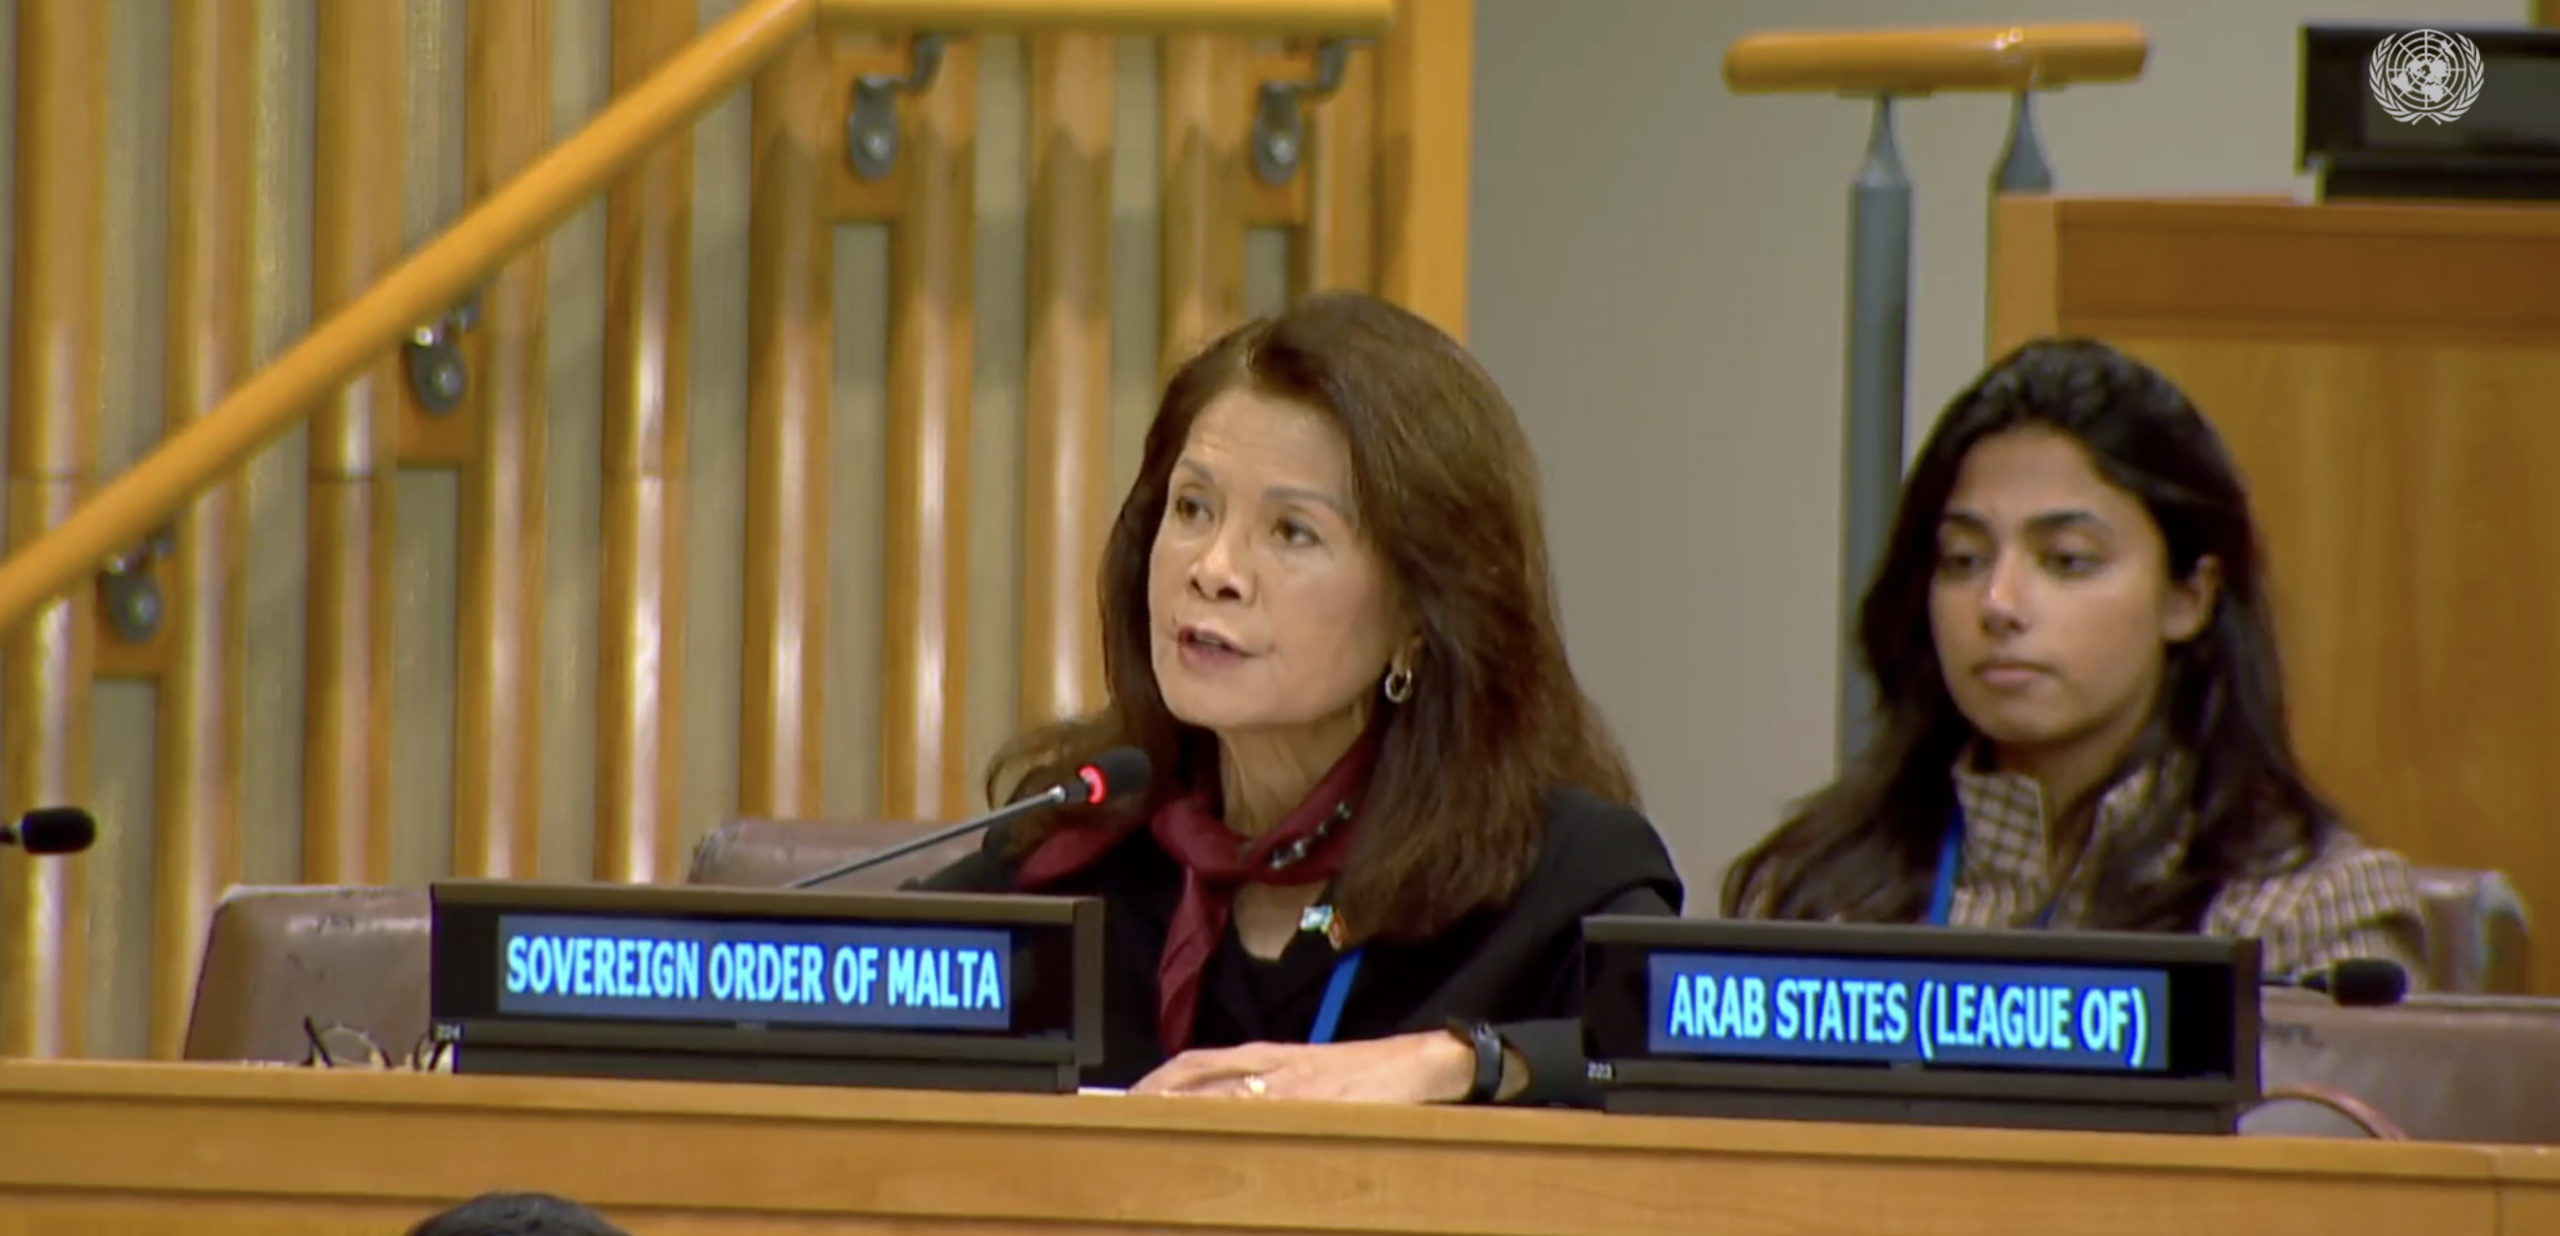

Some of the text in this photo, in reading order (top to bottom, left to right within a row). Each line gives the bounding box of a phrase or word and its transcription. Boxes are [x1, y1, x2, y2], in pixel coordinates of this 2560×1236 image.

[506, 936, 1000, 1008] SOVEREIGN ORDER OF MALTA
[1670, 975, 2147, 1066] ARAB STATES (LEAGUE OF)
